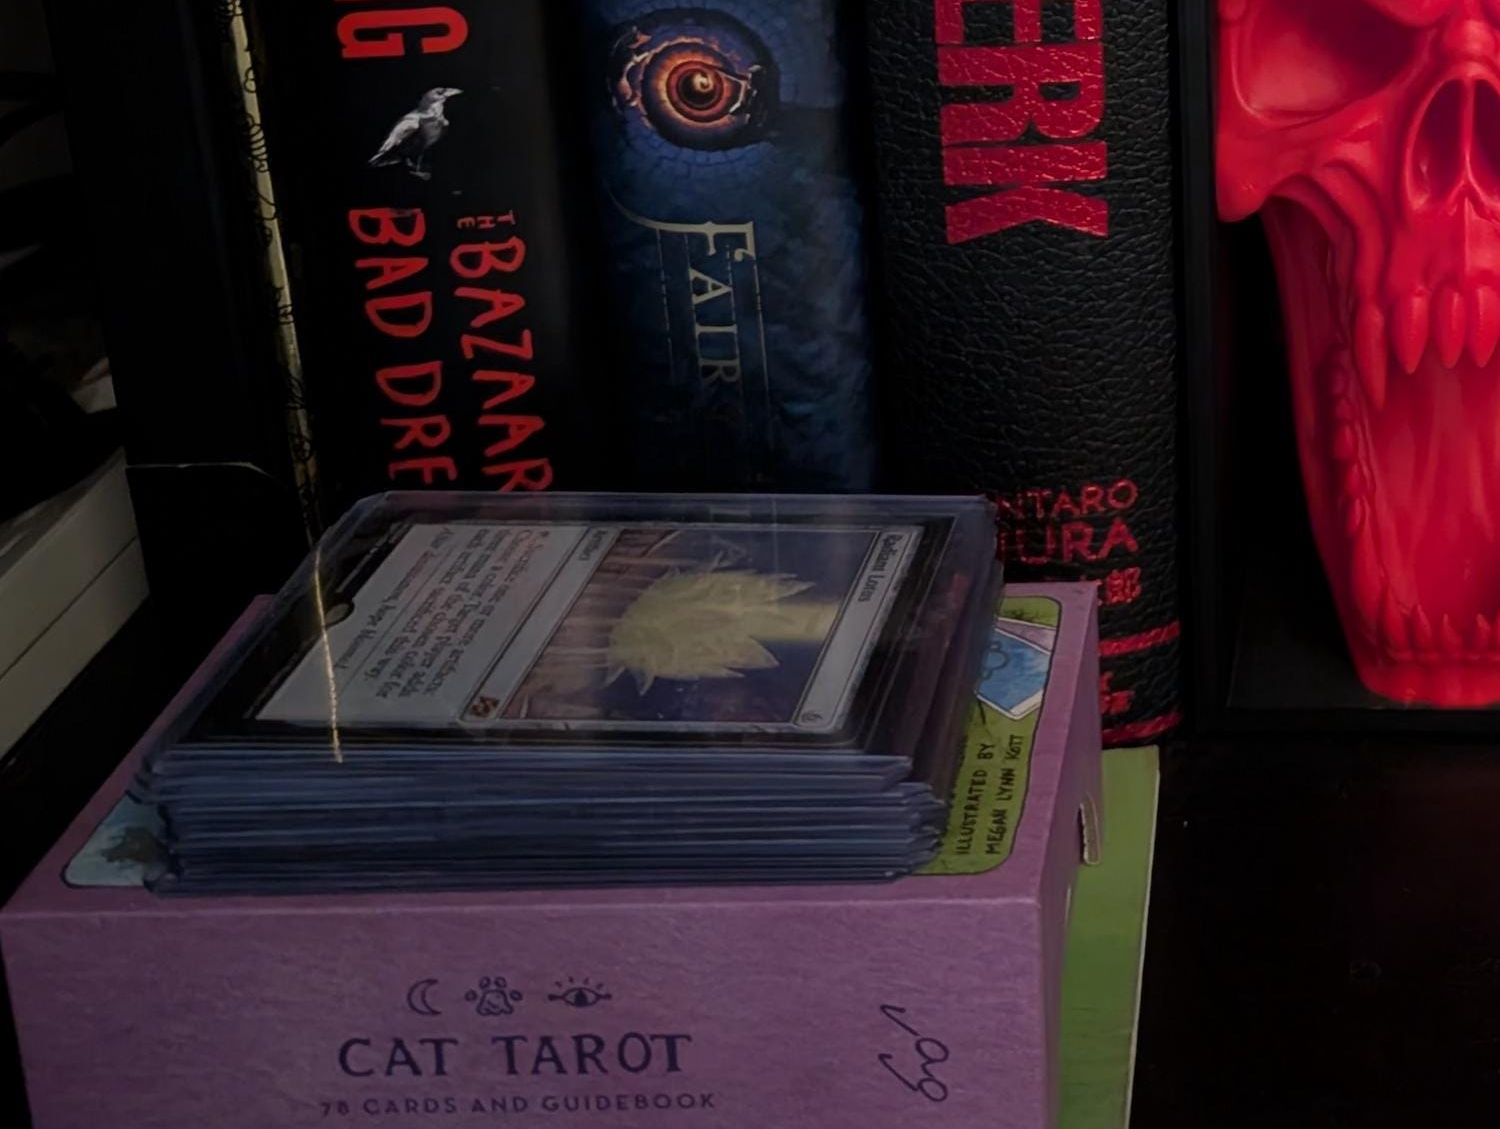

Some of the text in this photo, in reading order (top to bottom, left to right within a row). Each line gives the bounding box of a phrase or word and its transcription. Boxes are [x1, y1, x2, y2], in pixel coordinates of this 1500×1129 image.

[457, 210, 516, 229] THE
[348, 207, 434, 338] BAD
[450, 236, 553, 491] BAZAAR
[375, 361, 458, 485] DRE
[998, 479, 1139, 519] NTARO
[1001, 517, 1139, 564] IURA
[854, 534, 905, 602] Radiant Lotus
[955, 742, 994, 855] ILLUSTRATED BY
[996, 767, 1015, 801] LYNN
[986, 808, 1008, 855] MEGAN
[338, 1031, 693, 1077] CAT TAROT
[320, 1092, 716, 1117] 78 CARDS AND GUIDEBOOK
